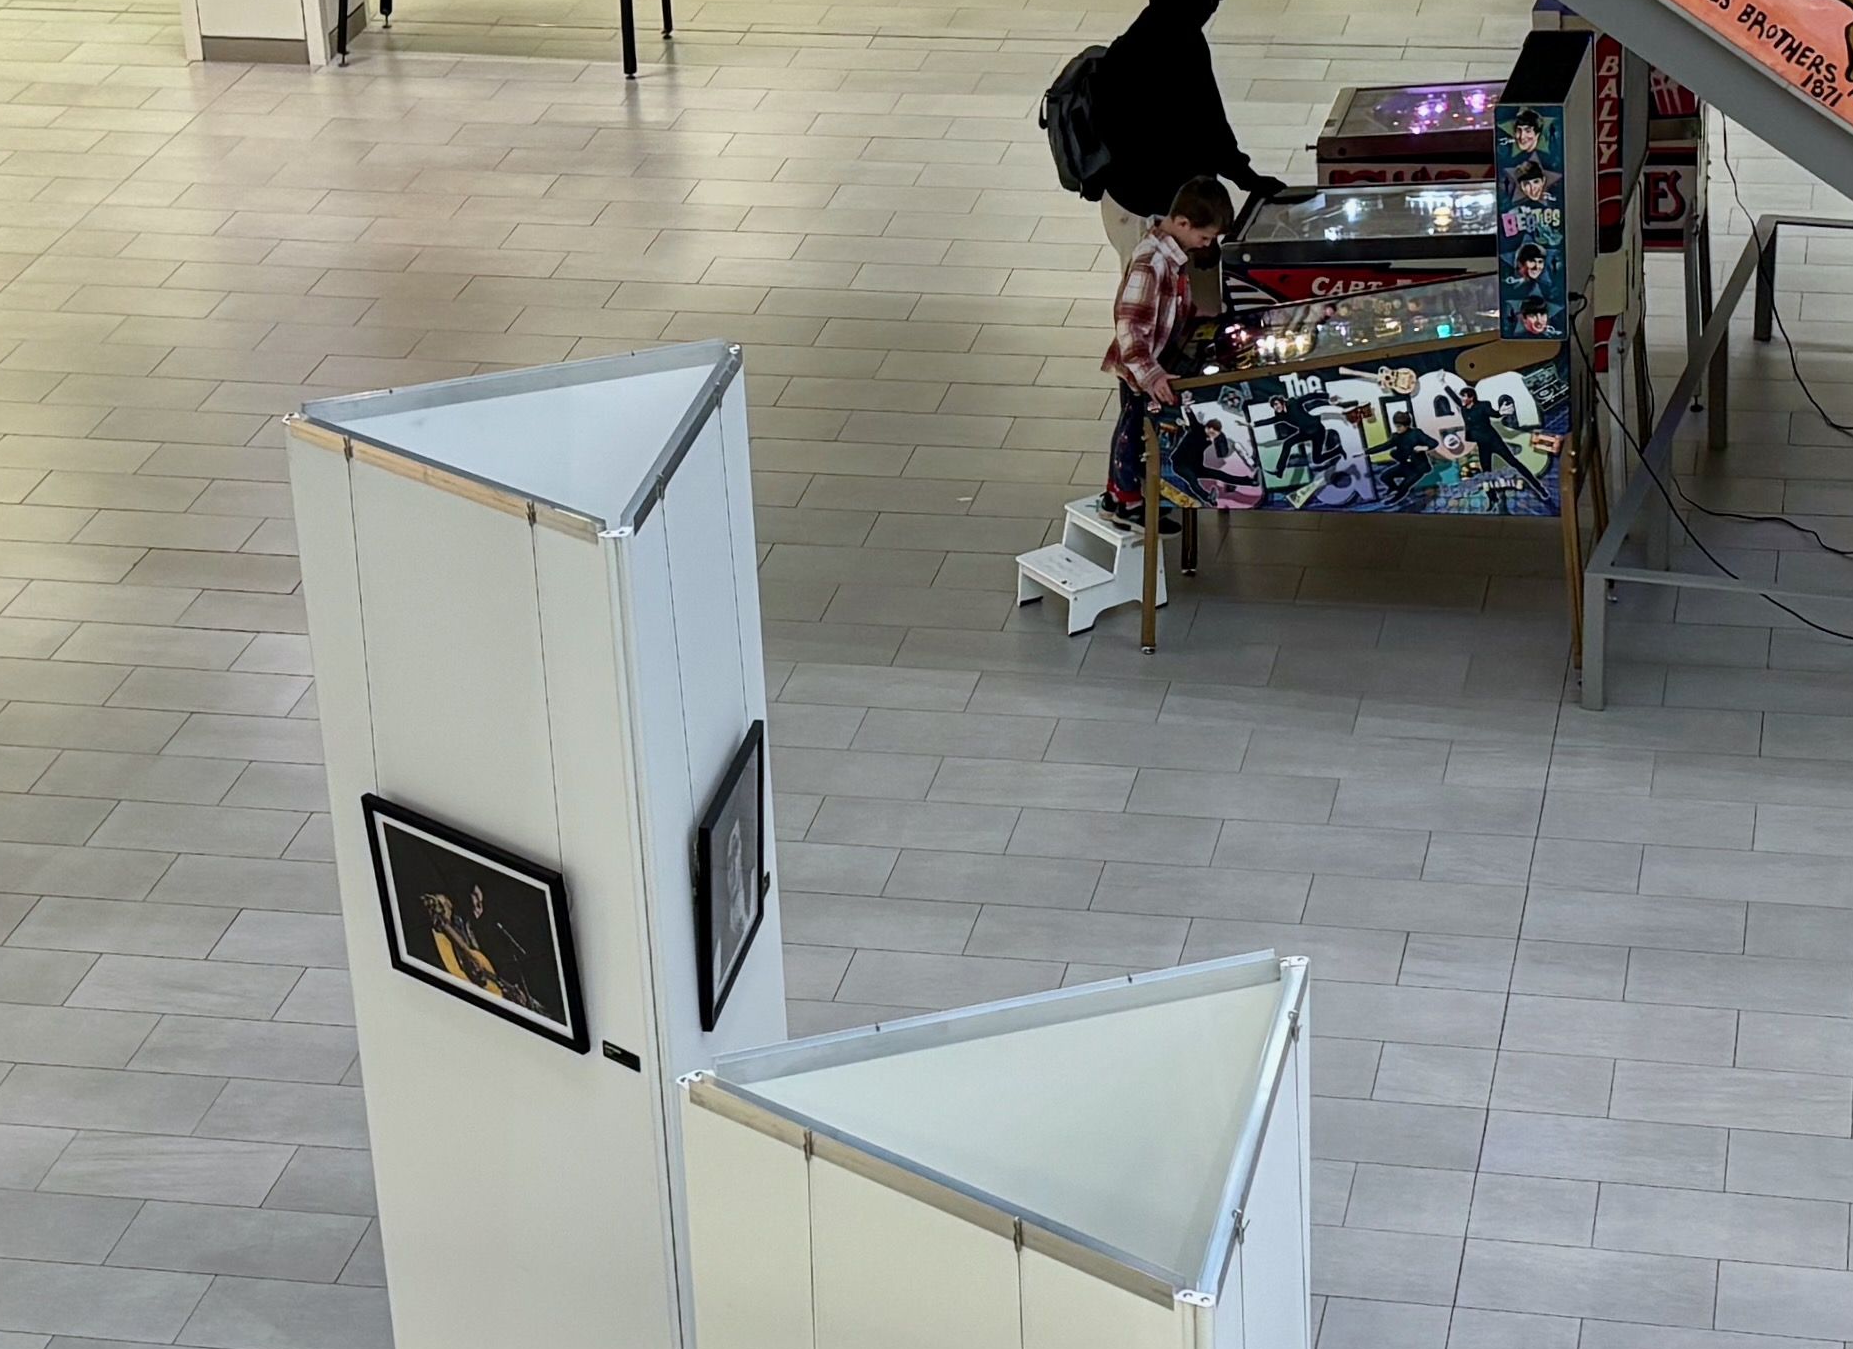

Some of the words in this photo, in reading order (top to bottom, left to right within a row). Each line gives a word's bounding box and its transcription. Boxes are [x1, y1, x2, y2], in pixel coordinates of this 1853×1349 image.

[1799, 73, 1844, 109] 1871
[1598, 55, 1620, 165] BALLY
[1279, 372, 1324, 399] The
